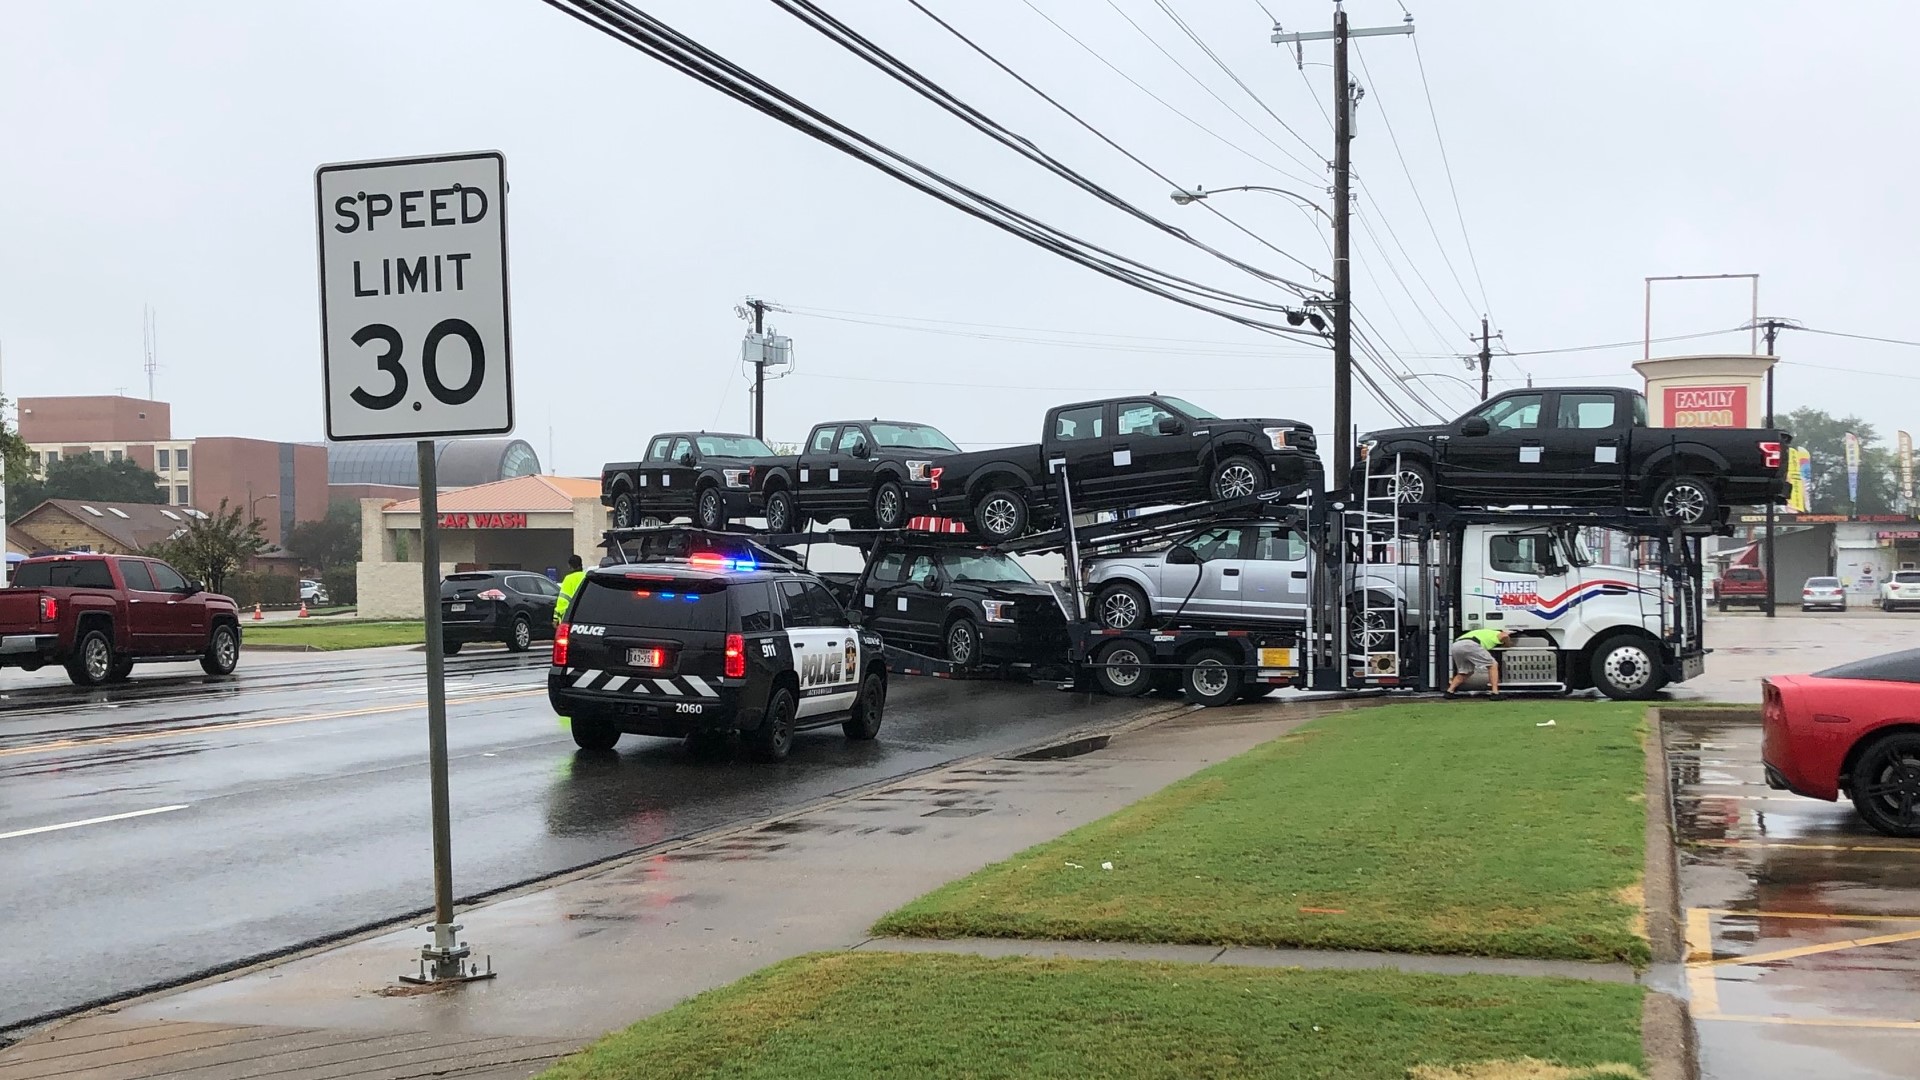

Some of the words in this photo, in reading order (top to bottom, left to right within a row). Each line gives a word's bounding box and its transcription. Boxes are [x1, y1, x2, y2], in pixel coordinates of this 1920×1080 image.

[335, 186, 488, 234] SPEED
[353, 253, 471, 297] LIMIT
[349, 318, 486, 410] 30
[1675, 390, 1735, 408] FAMILY
[473, 512, 527, 529] WASH
[1495, 581, 1537, 594] HANSEN
[1495, 595, 1501, 606] &
[570, 624, 606, 636] POLICE
[761, 643, 777, 658] 911
[801, 653, 843, 688] POLICE
[675, 702, 703, 714] 2060
